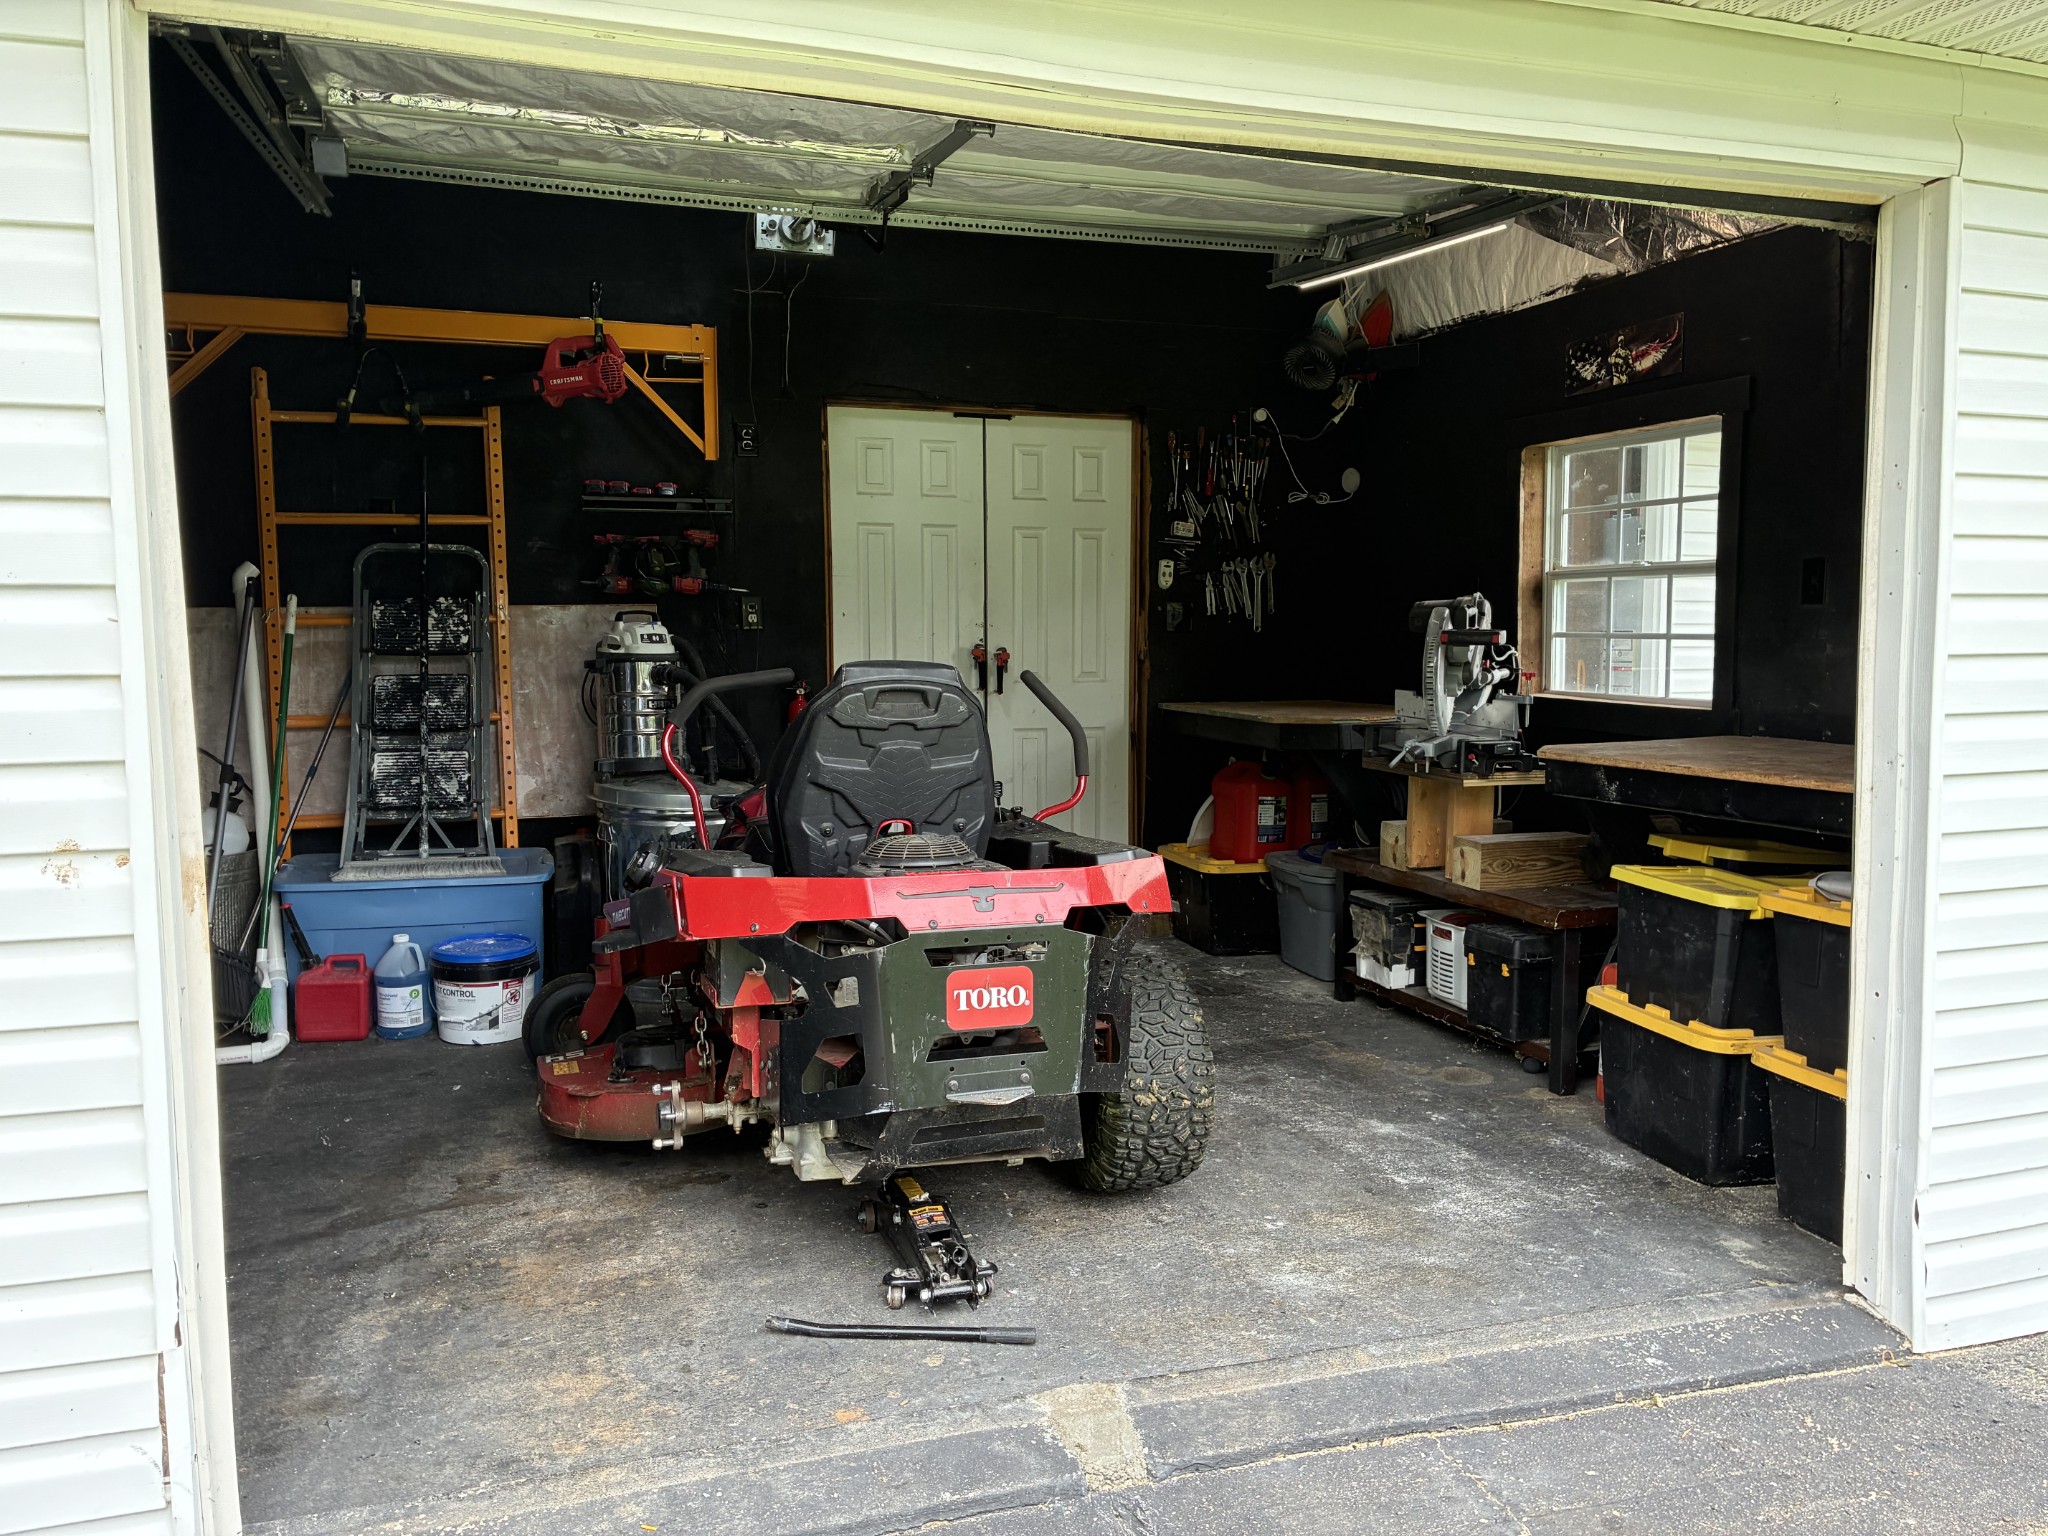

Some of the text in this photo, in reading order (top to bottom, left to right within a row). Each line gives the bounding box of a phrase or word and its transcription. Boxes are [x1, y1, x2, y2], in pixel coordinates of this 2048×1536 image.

[550, 375, 583, 385] CRAFTSMAN
[442, 987, 476, 998] CONTROL
[953, 985, 1027, 1011] TORO
